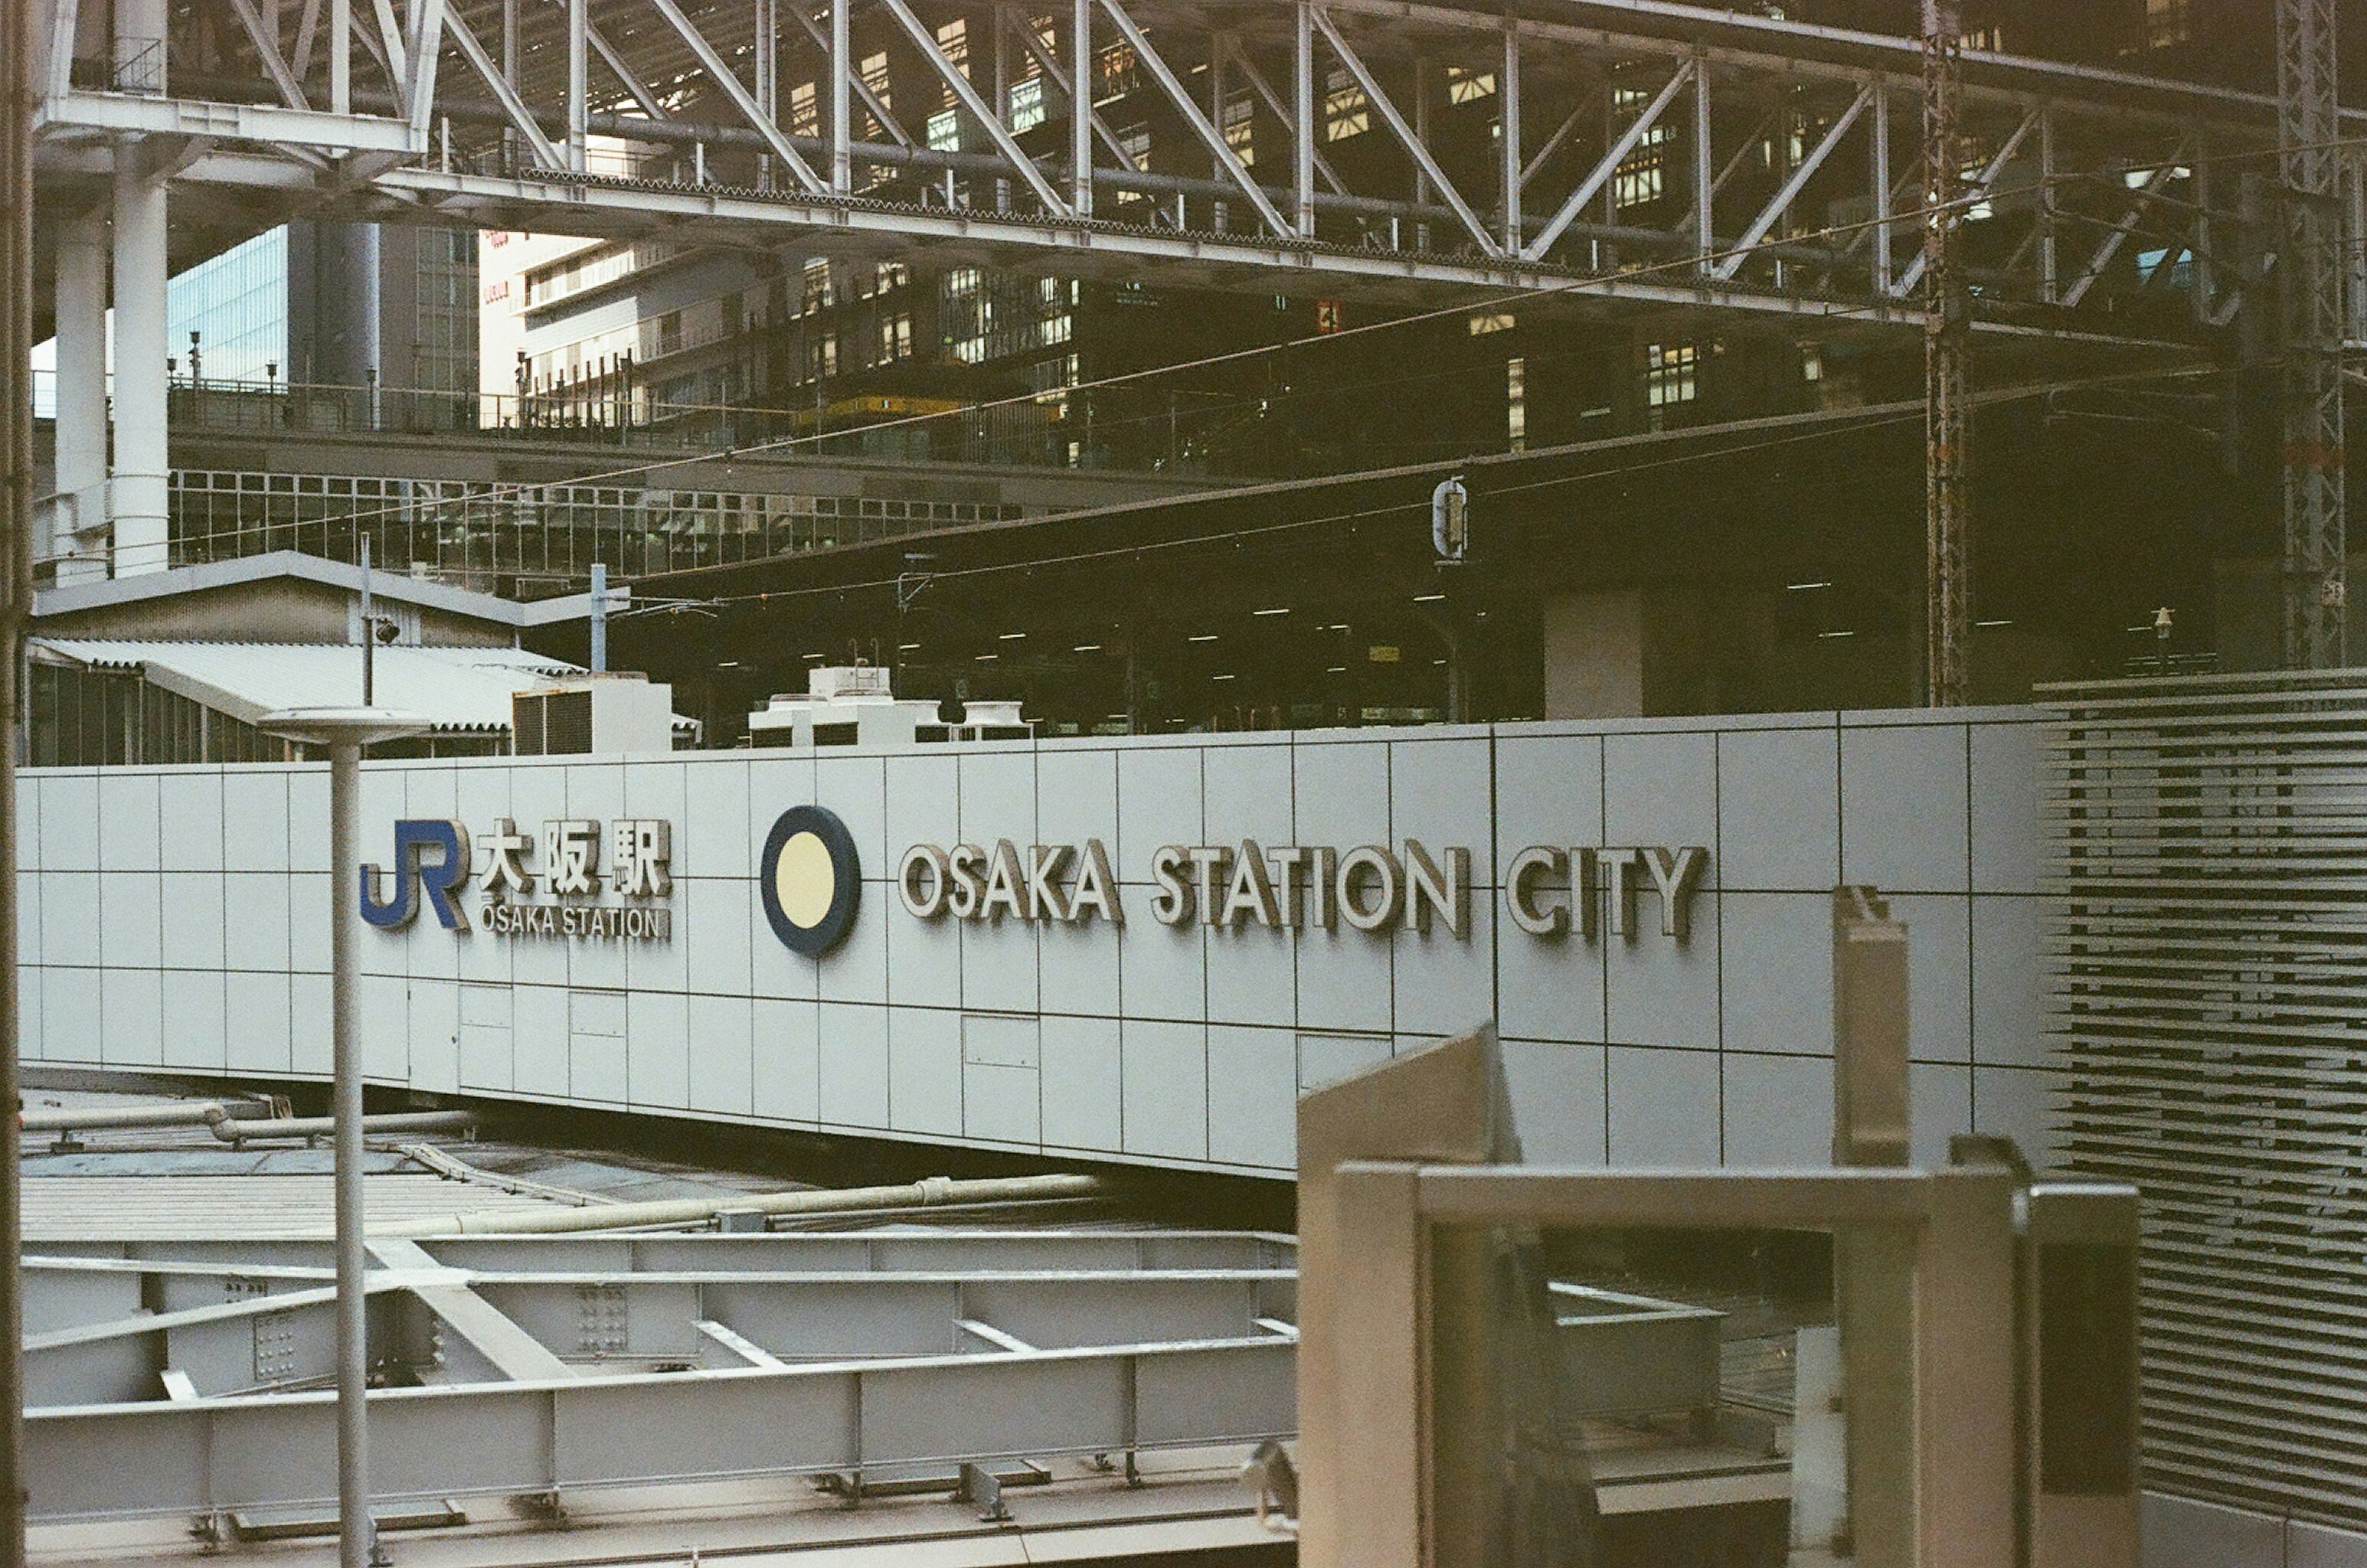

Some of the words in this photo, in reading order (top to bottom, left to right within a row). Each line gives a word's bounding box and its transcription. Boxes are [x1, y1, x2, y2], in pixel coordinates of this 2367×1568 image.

[359, 819, 469, 929] JR
[477, 818, 669, 896] 大阪駅
[899, 838, 1123, 921] OSAKA
[1150, 839, 1469, 939] STATION
[1506, 846, 1708, 936] CITY
[561, 905, 666, 938] STATION
